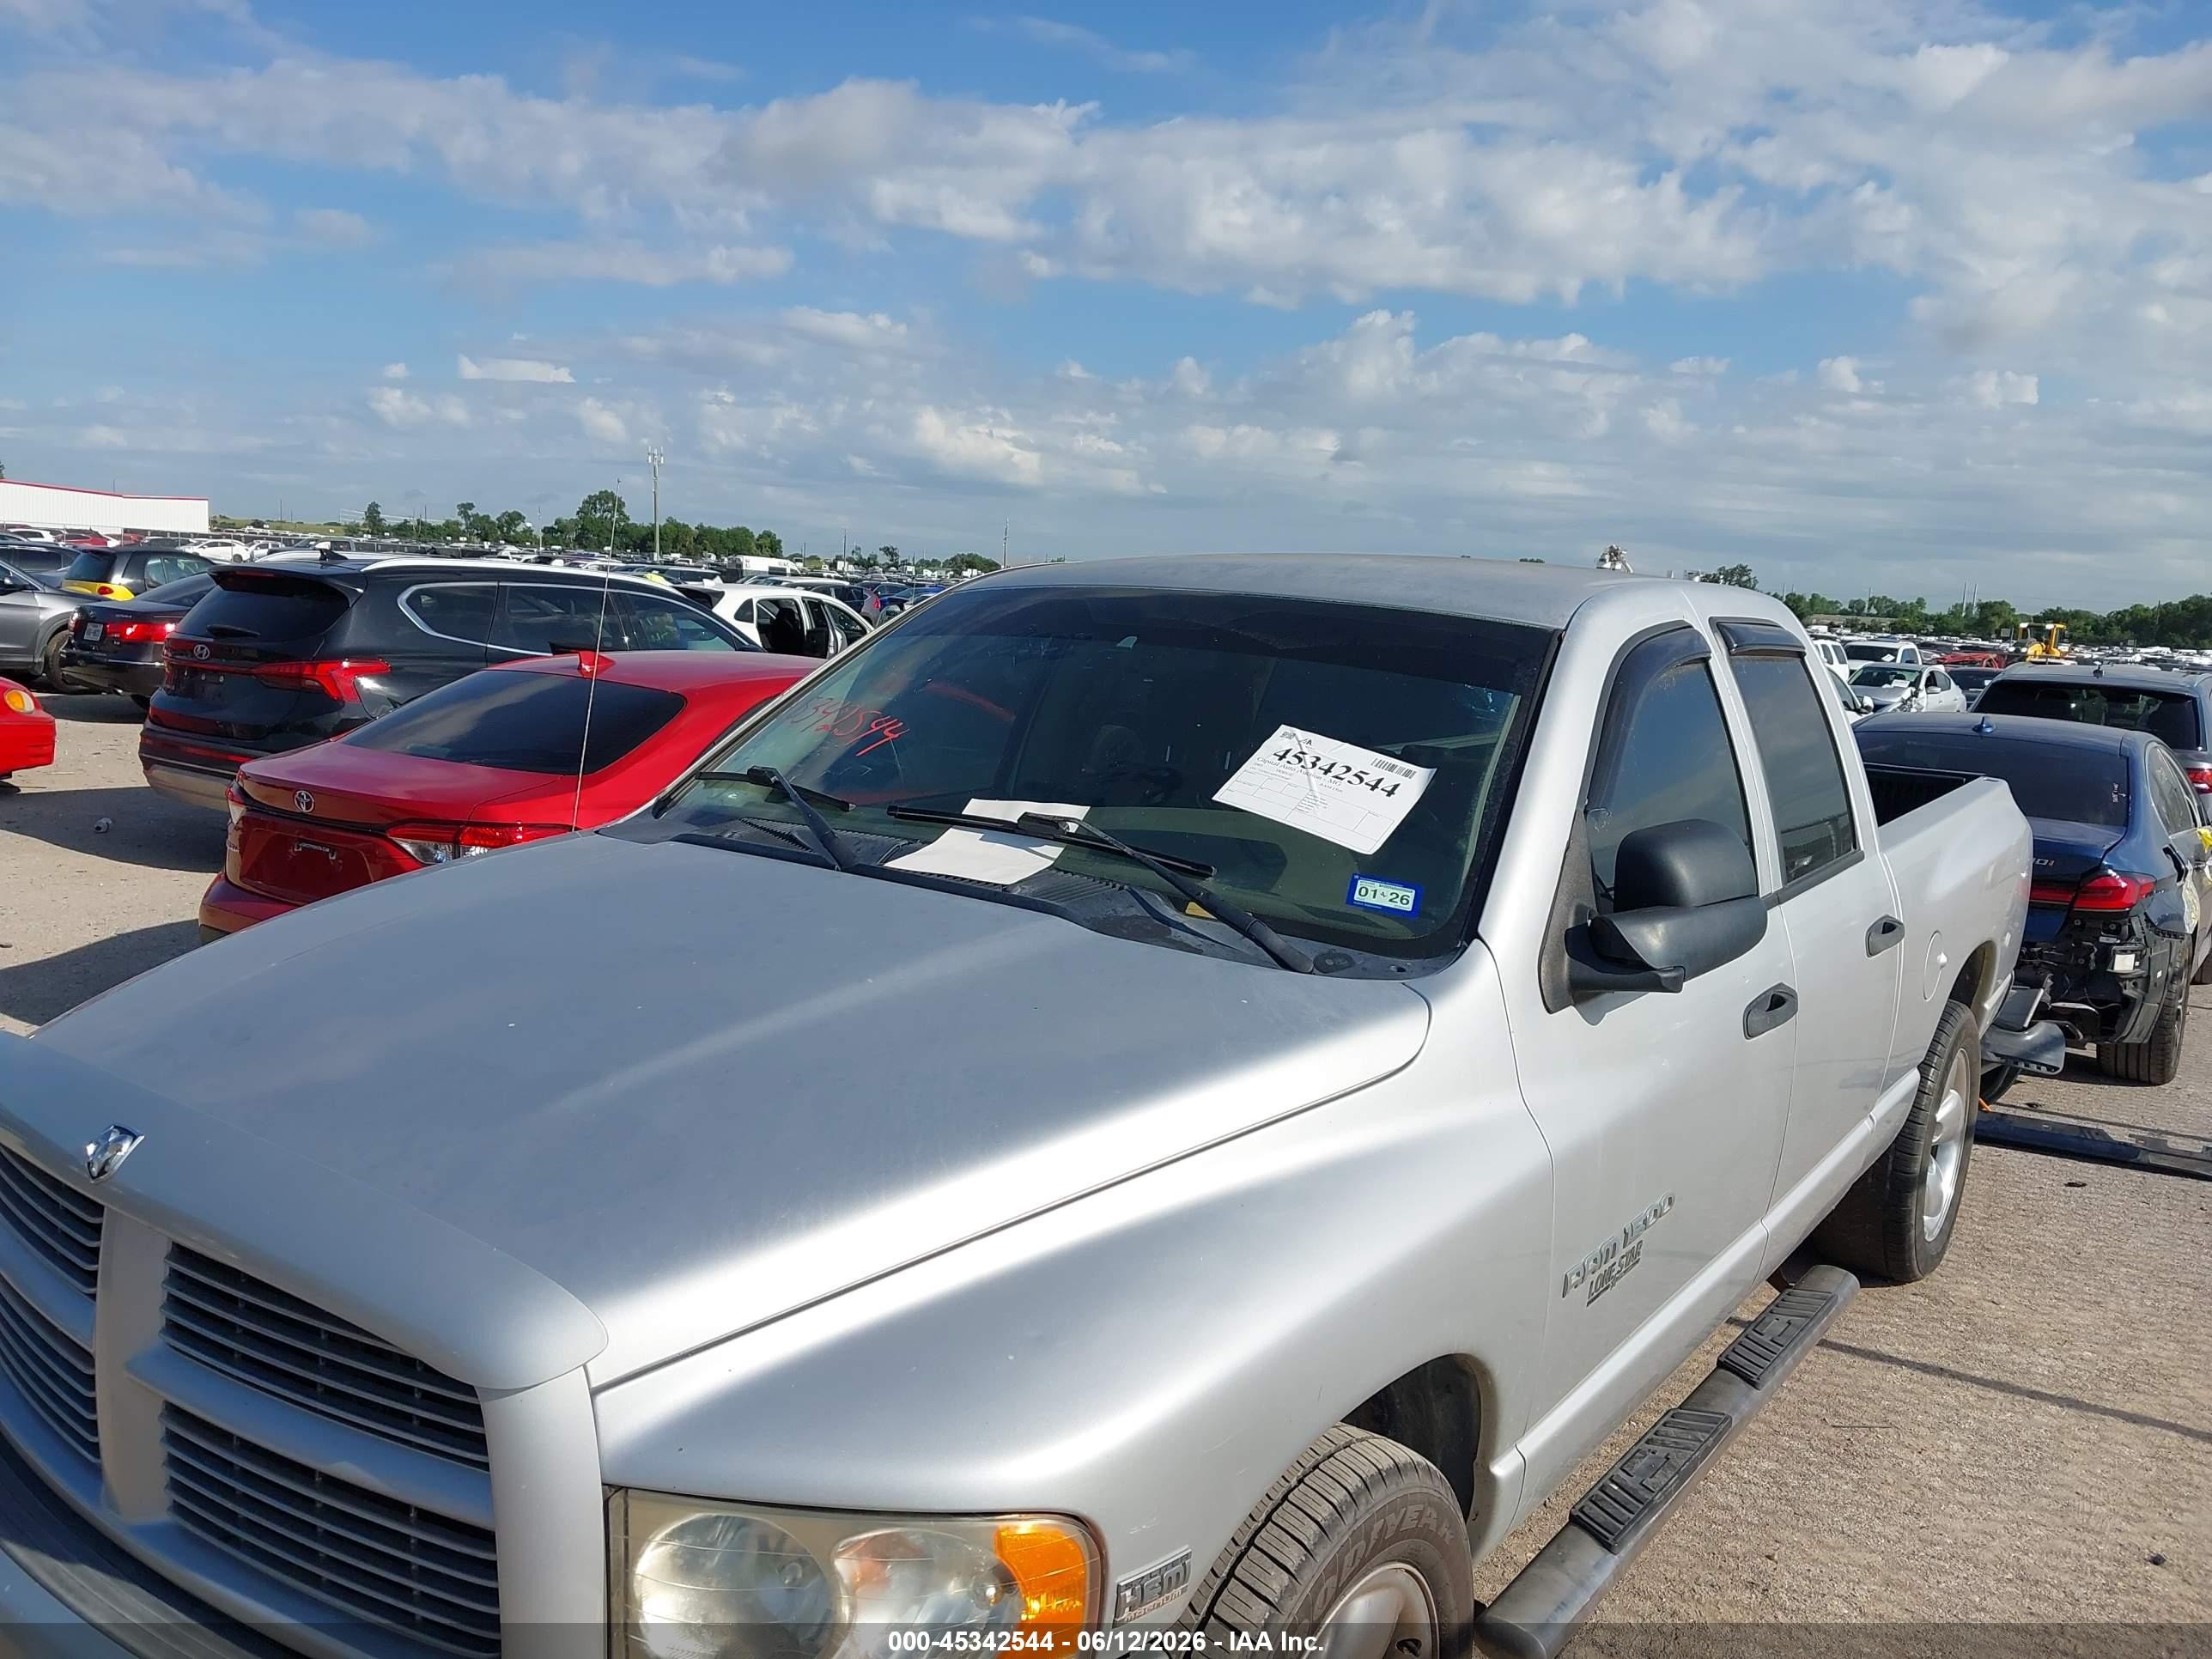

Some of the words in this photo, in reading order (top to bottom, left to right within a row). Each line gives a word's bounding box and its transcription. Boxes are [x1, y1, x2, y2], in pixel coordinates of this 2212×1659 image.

[1256, 757, 1280, 767] Capital
[1280, 761, 1296, 772] Auto
[1273, 747, 1401, 797] 45342544
[1358, 885, 1377, 899] 01
[1389, 891, 1411, 906] 26
[1622, 1191, 1676, 1249] 1500
[1588, 1261, 1617, 1300] LONE
[1617, 1239, 1644, 1276] STAR
